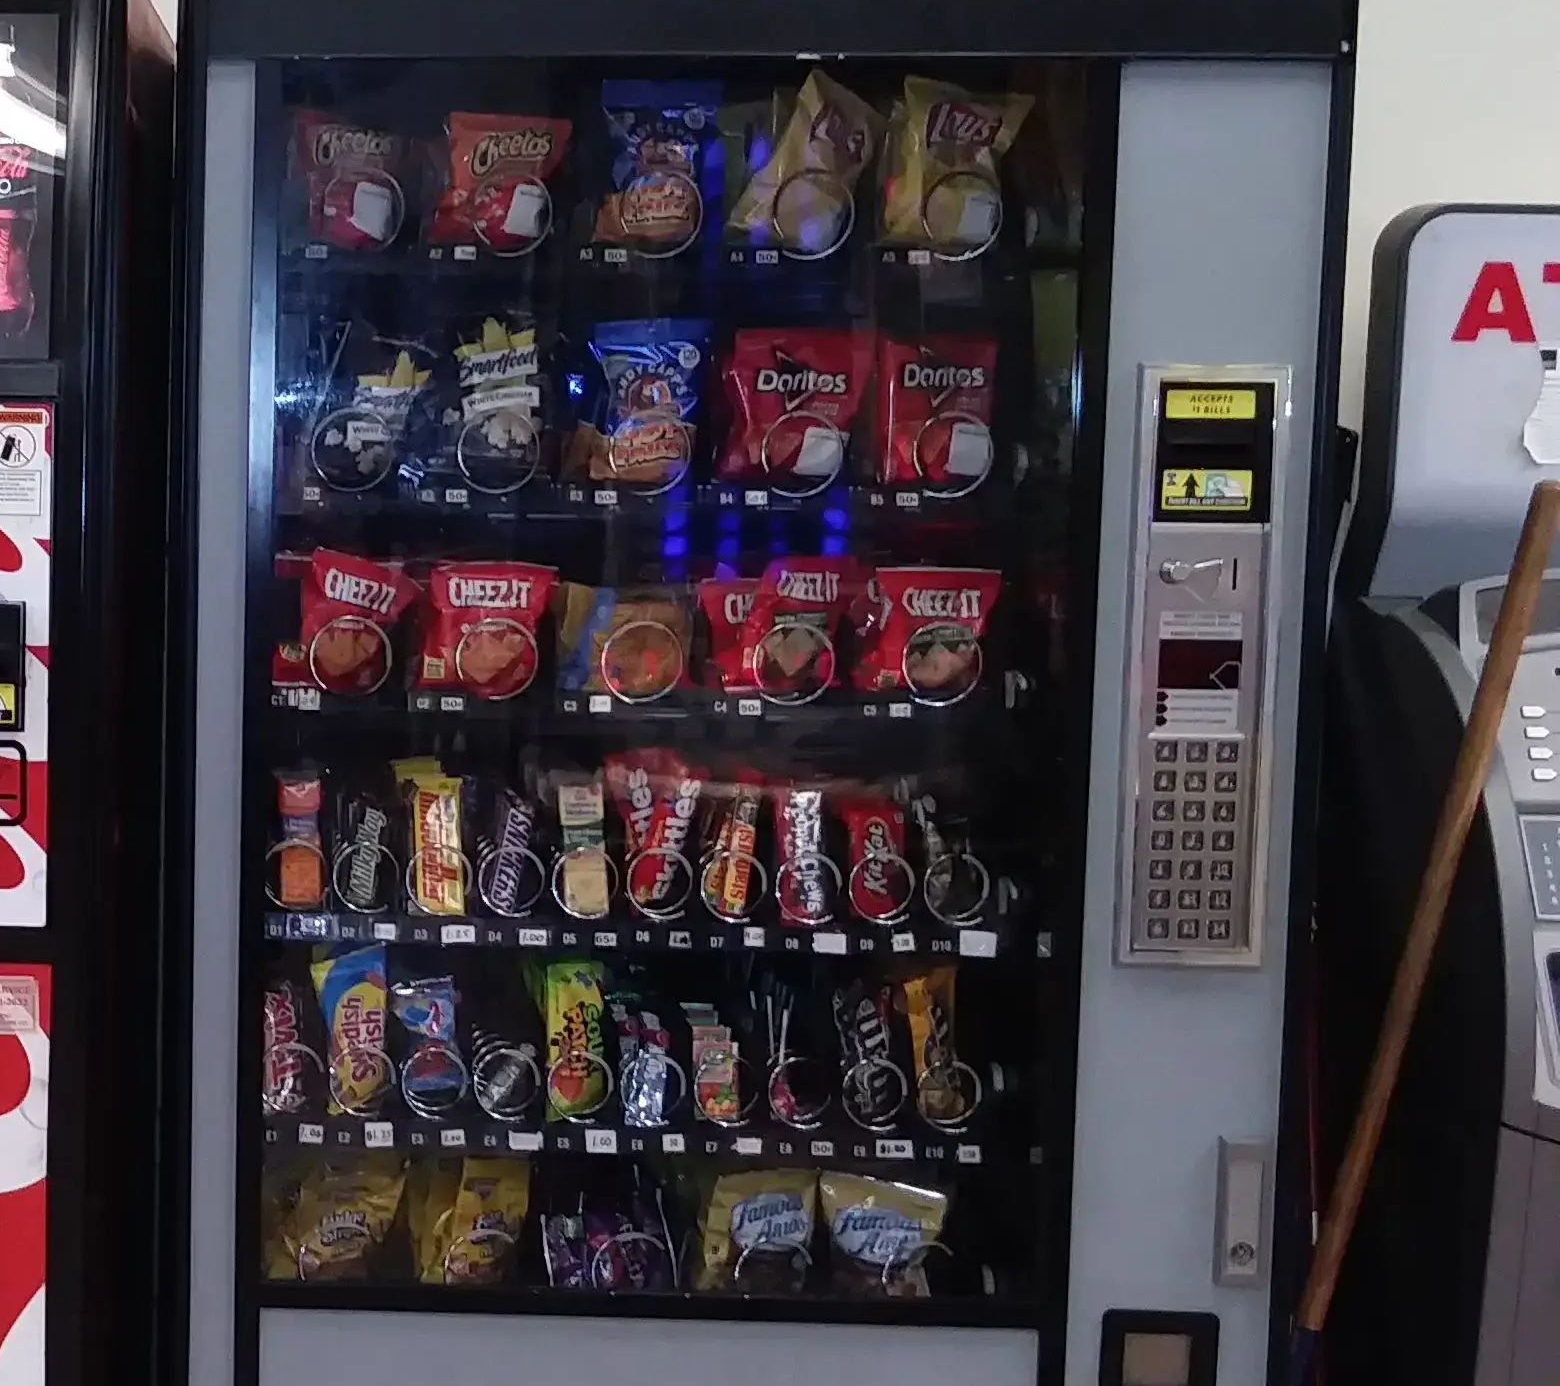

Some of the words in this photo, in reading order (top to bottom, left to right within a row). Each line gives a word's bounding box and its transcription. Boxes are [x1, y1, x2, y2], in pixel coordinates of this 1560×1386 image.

[314, 126, 392, 167] Cheetos
[470, 127, 553, 176] Cheetos
[757, 369, 846, 393] Doritos
[903, 363, 984, 388] Doritos
[1189, 395, 1233, 403] ACCEPTS
[1203, 406, 1231, 414] BILLS
[710, 937, 724, 948] D7
[932, 940, 952, 951] D10
[340, 994, 377, 1083] Swedish
[737, 1198, 804, 1231] Famous
